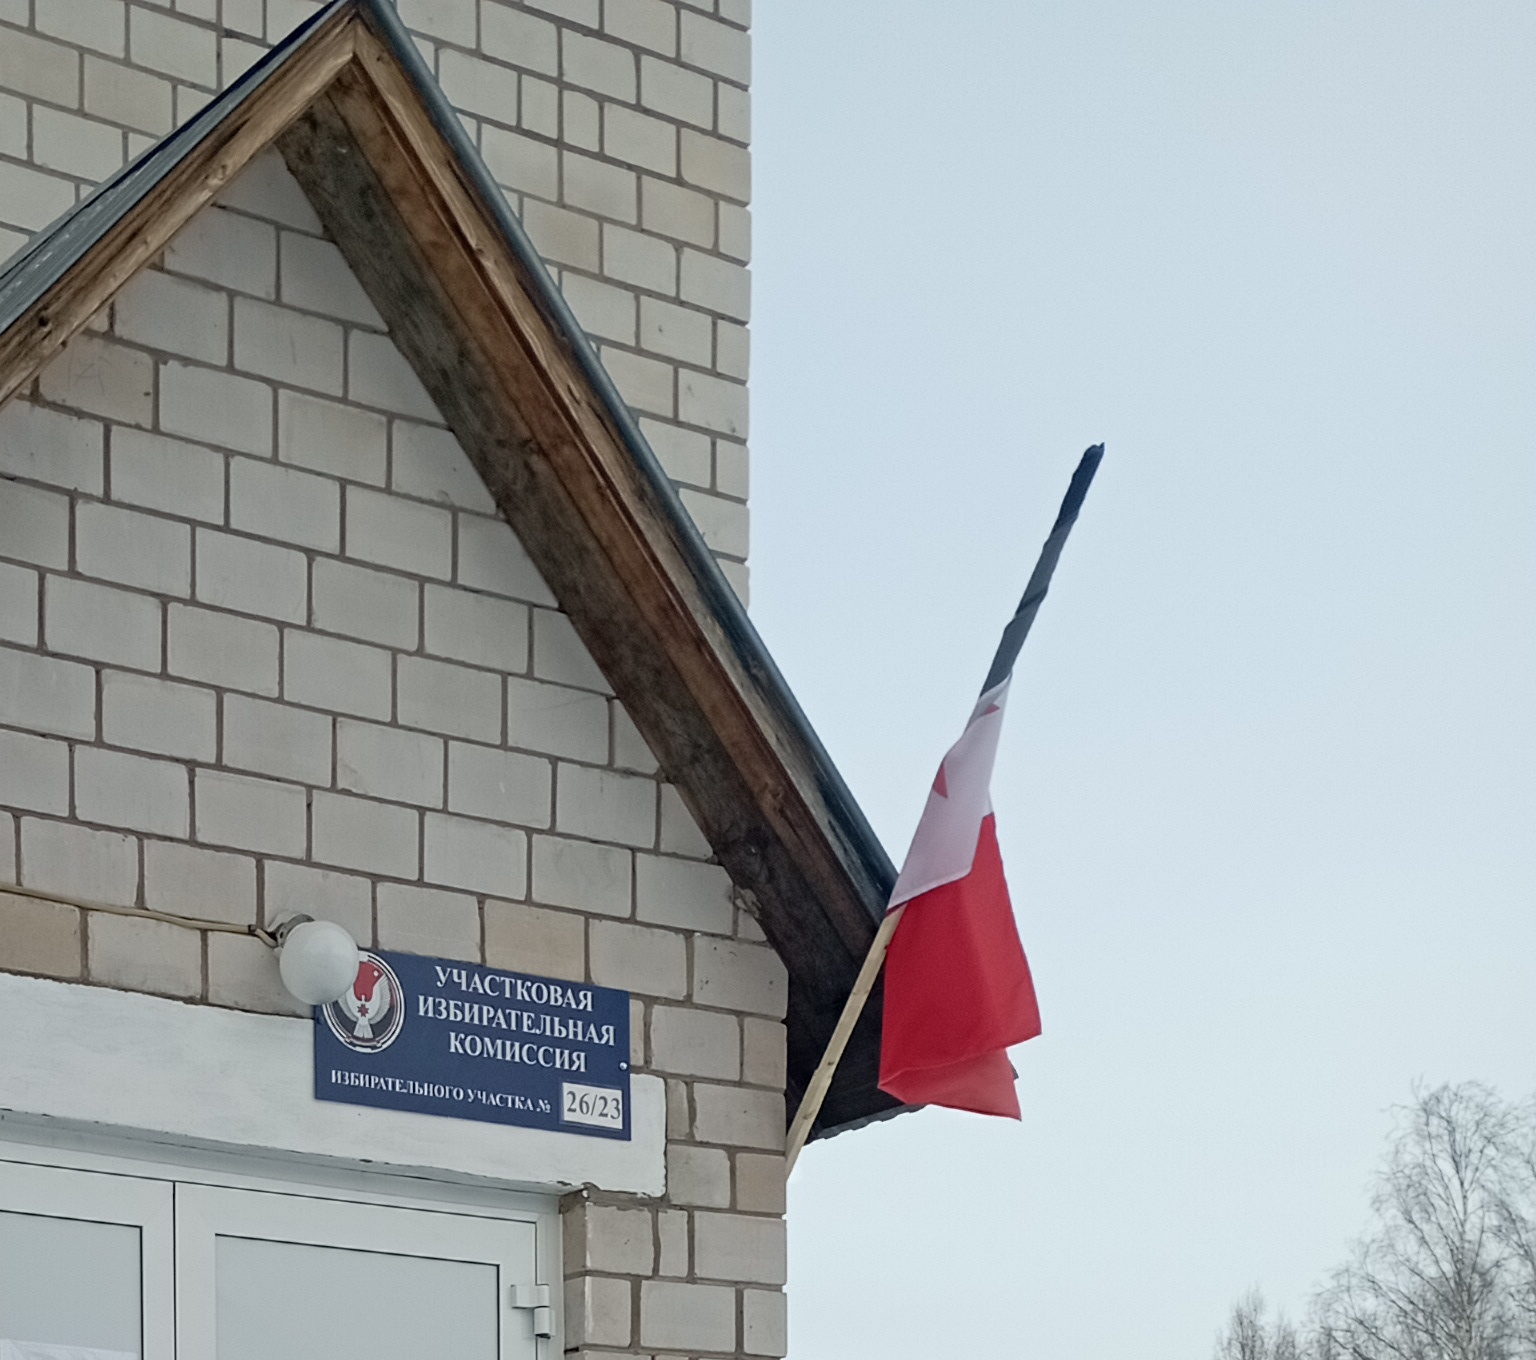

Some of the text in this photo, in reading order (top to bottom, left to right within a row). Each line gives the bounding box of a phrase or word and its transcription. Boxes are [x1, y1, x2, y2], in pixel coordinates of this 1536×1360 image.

[434, 965, 594, 1012] УЧАСТКОВАЯ
[417, 995, 616, 1046] ИЗБИРАТЕЛЬНАЯ
[448, 1031, 587, 1073] КОМИССИЯ
[330, 1069, 465, 1101] ИЗБИРАТЕЛЬНОГО
[467, 1086, 534, 1112] УЧАСТКА
[565, 1090, 622, 1120] 26/23
